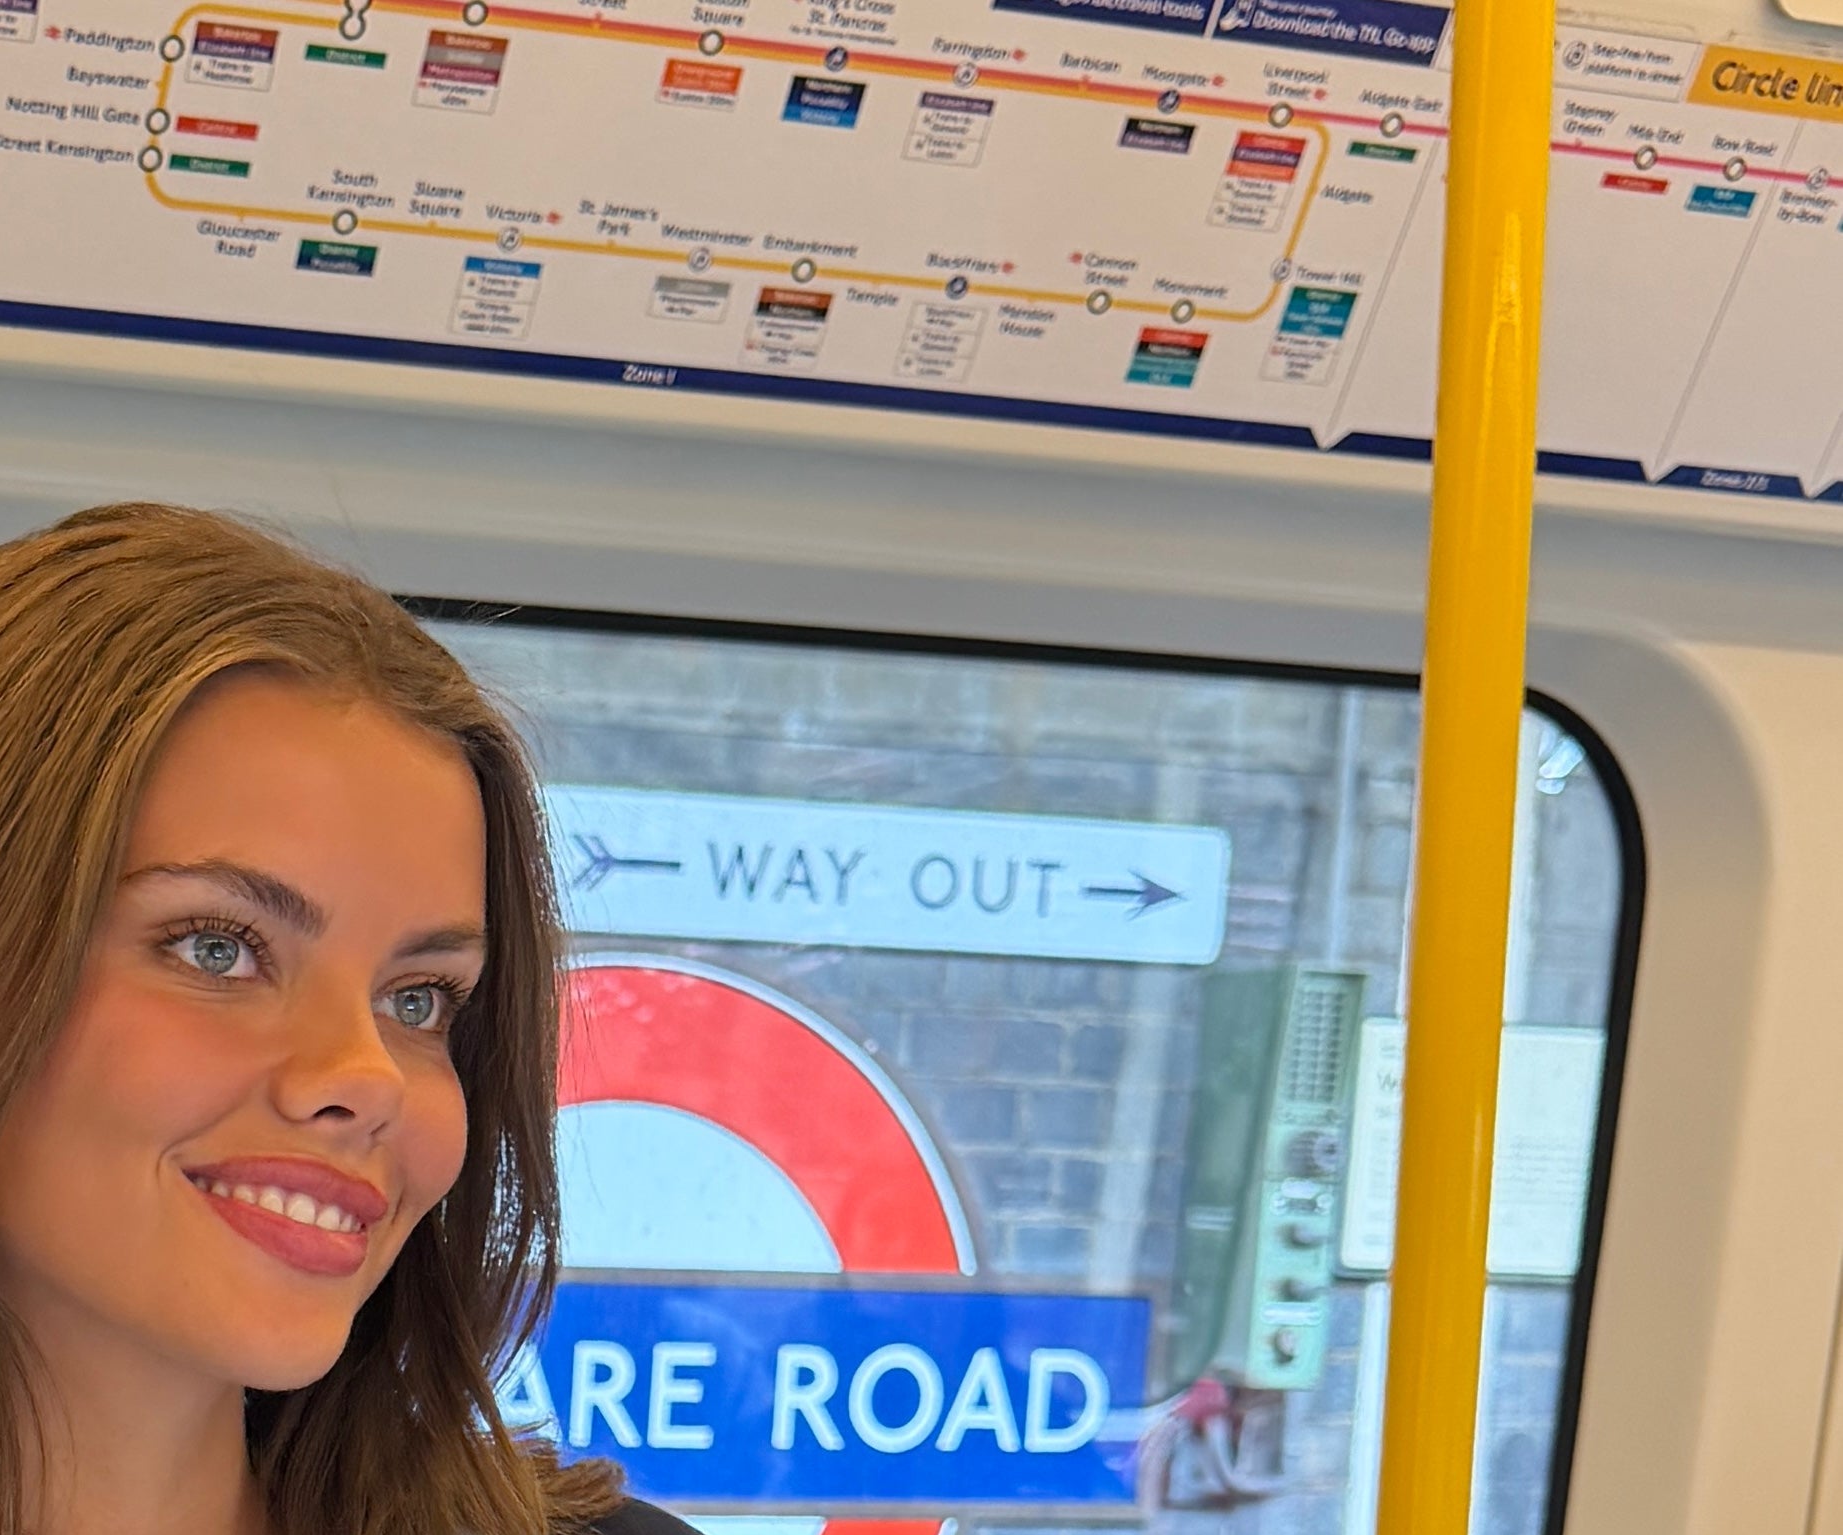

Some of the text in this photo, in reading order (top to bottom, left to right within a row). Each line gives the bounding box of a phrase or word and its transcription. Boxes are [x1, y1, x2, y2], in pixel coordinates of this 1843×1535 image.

[64, 28, 155, 54] Paddington
[1330, 19, 1357, 42] the
[66, 65, 151, 90] Bayswater
[1712, 60, 1843, 107] Circle lin
[6, 95, 142, 126] Notting Hill Gate
[45, 138, 134, 164] Kensington
[331, 169, 377, 188] South
[414, 181, 466, 200] Sloane
[306, 184, 395, 209] Kensington
[408, 199, 463, 219] Square
[485, 204, 543, 223] Victoria
[196, 219, 281, 242] Gloucester
[660, 223, 753, 247] Westminster
[214, 239, 257, 258] Road
[762, 233, 858, 258] Embankment
[621, 363, 664, 385] Zone
[707, 840, 1065, 917] WAY OUT
[769, 1341, 1112, 1454] ROAD
